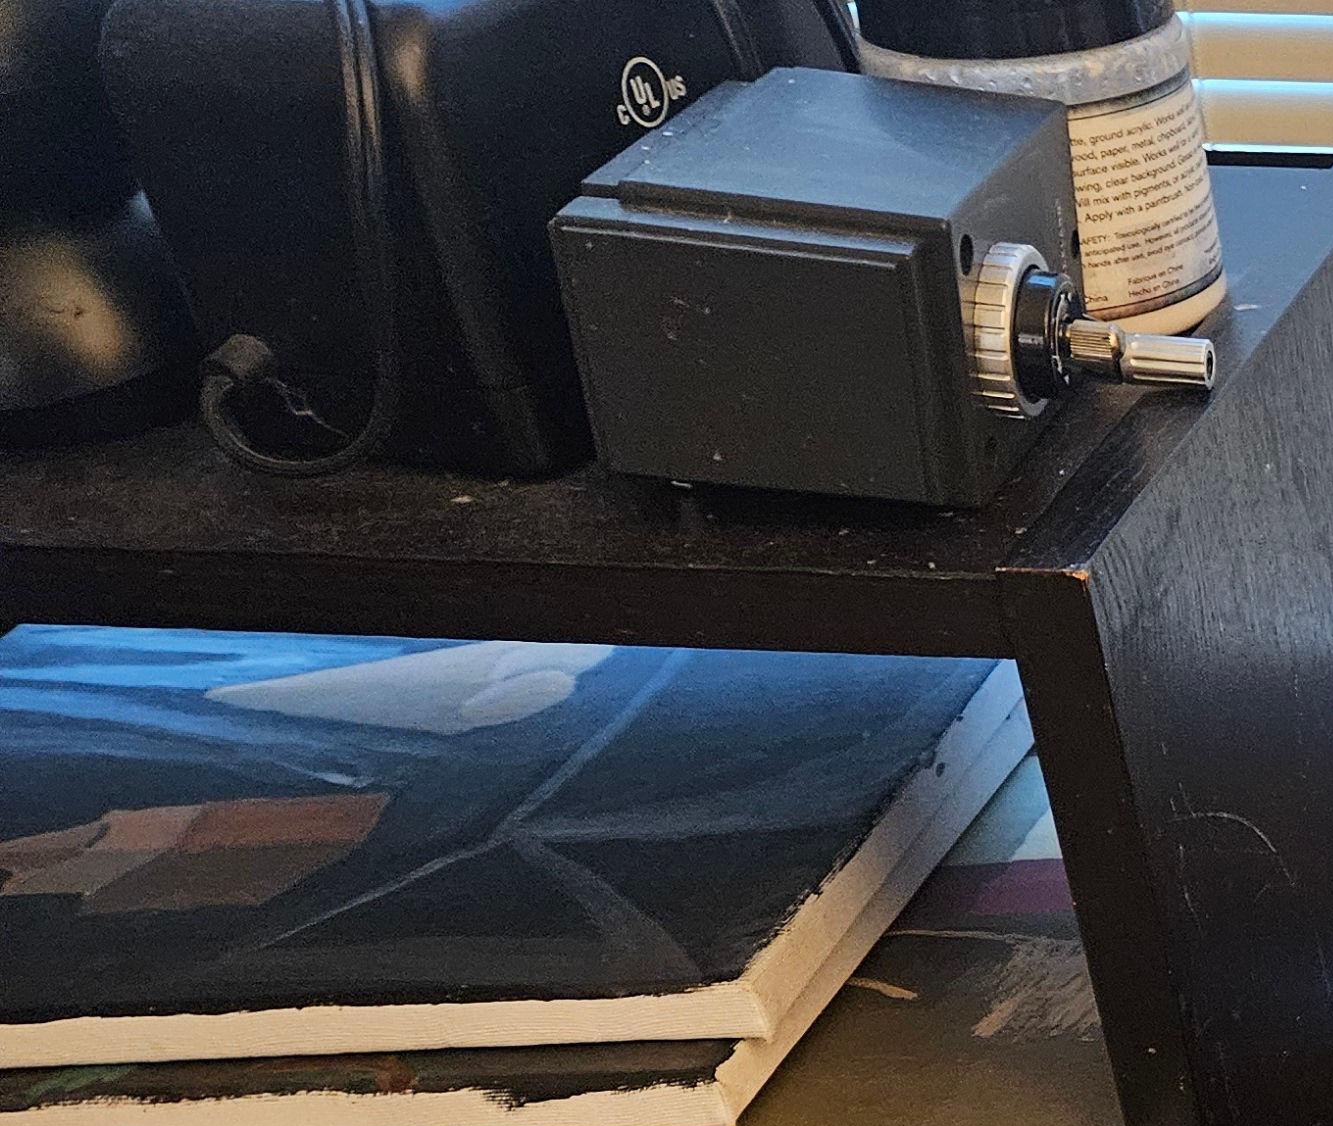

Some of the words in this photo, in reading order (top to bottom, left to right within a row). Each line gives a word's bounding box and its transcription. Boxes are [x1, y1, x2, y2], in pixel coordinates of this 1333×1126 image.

[1088, 130, 1123, 146] ground
[1072, 152, 1097, 162] ood,
[1075, 182, 1103, 194] wing,
[1105, 177, 1129, 189] clear
[1092, 197, 1110, 207] mix
[1111, 191, 1132, 203] with
[1085, 211, 1113, 224] Apply
[1116, 206, 1135, 216] with
